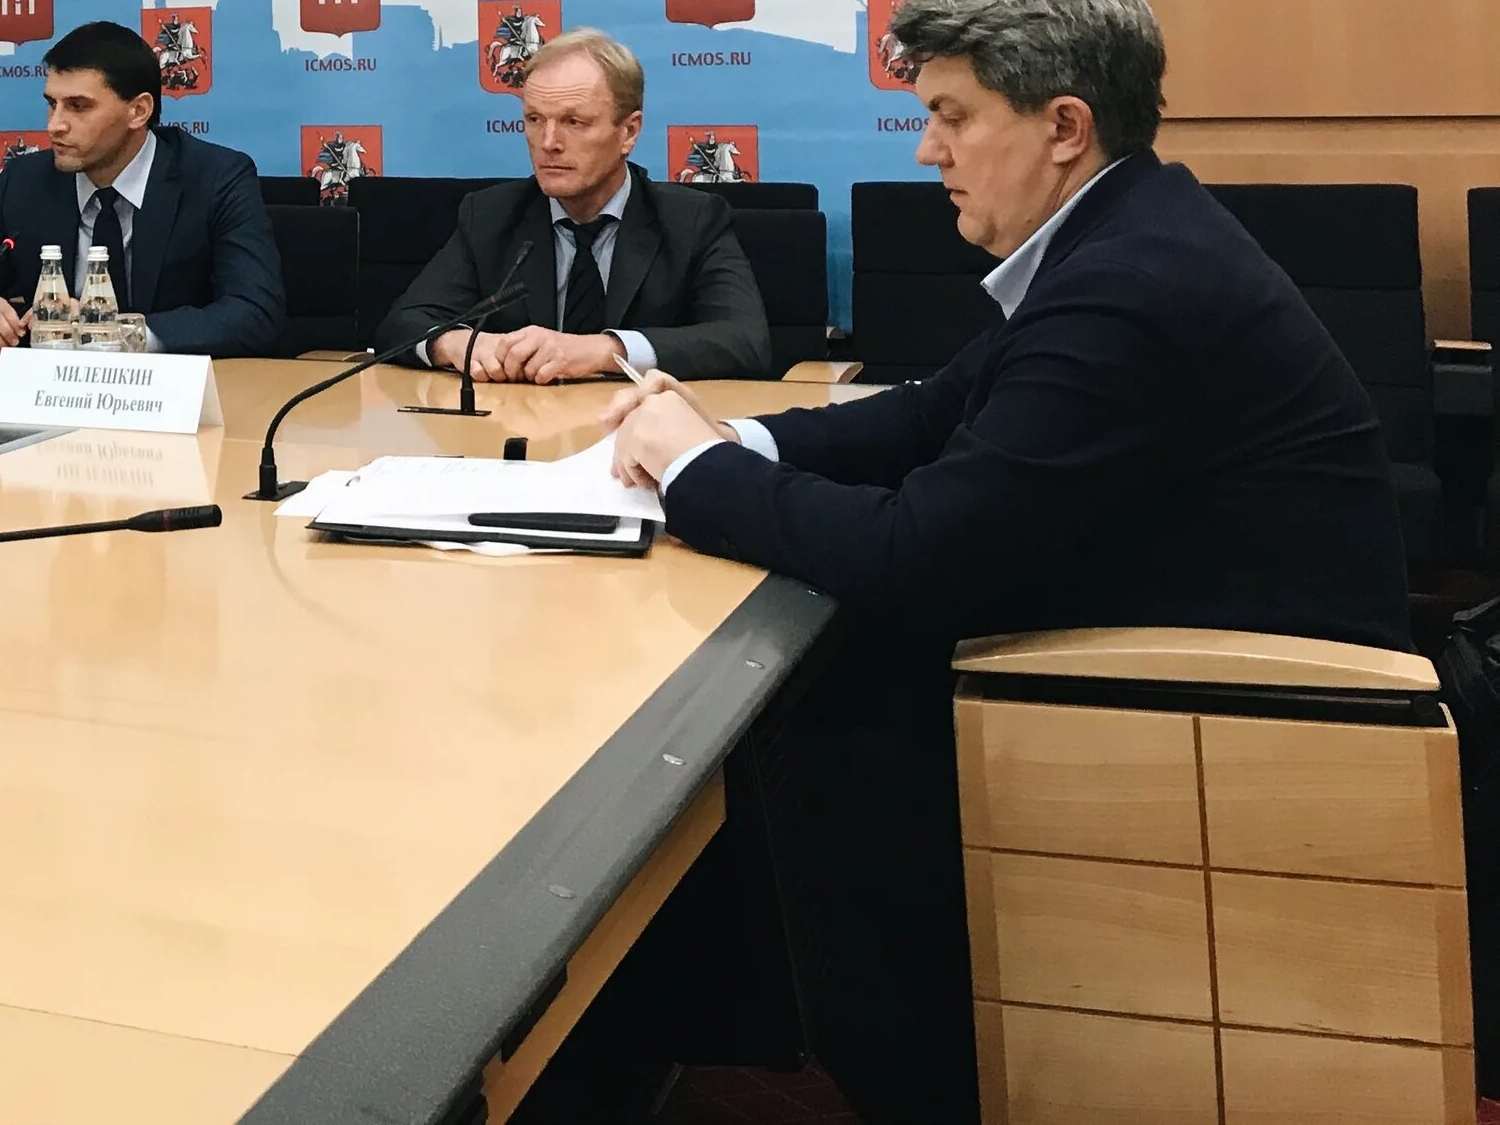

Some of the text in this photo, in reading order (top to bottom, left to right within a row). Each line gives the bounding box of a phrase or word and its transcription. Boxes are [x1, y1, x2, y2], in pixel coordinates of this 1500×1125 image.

[305, 58, 377, 72] ICMOS.RU
[673, 52, 751, 66] ICMOS.RU
[53, 365, 154, 386] МИЛЕШКИН
[34, 390, 163, 415] Евгений Юрьевич
